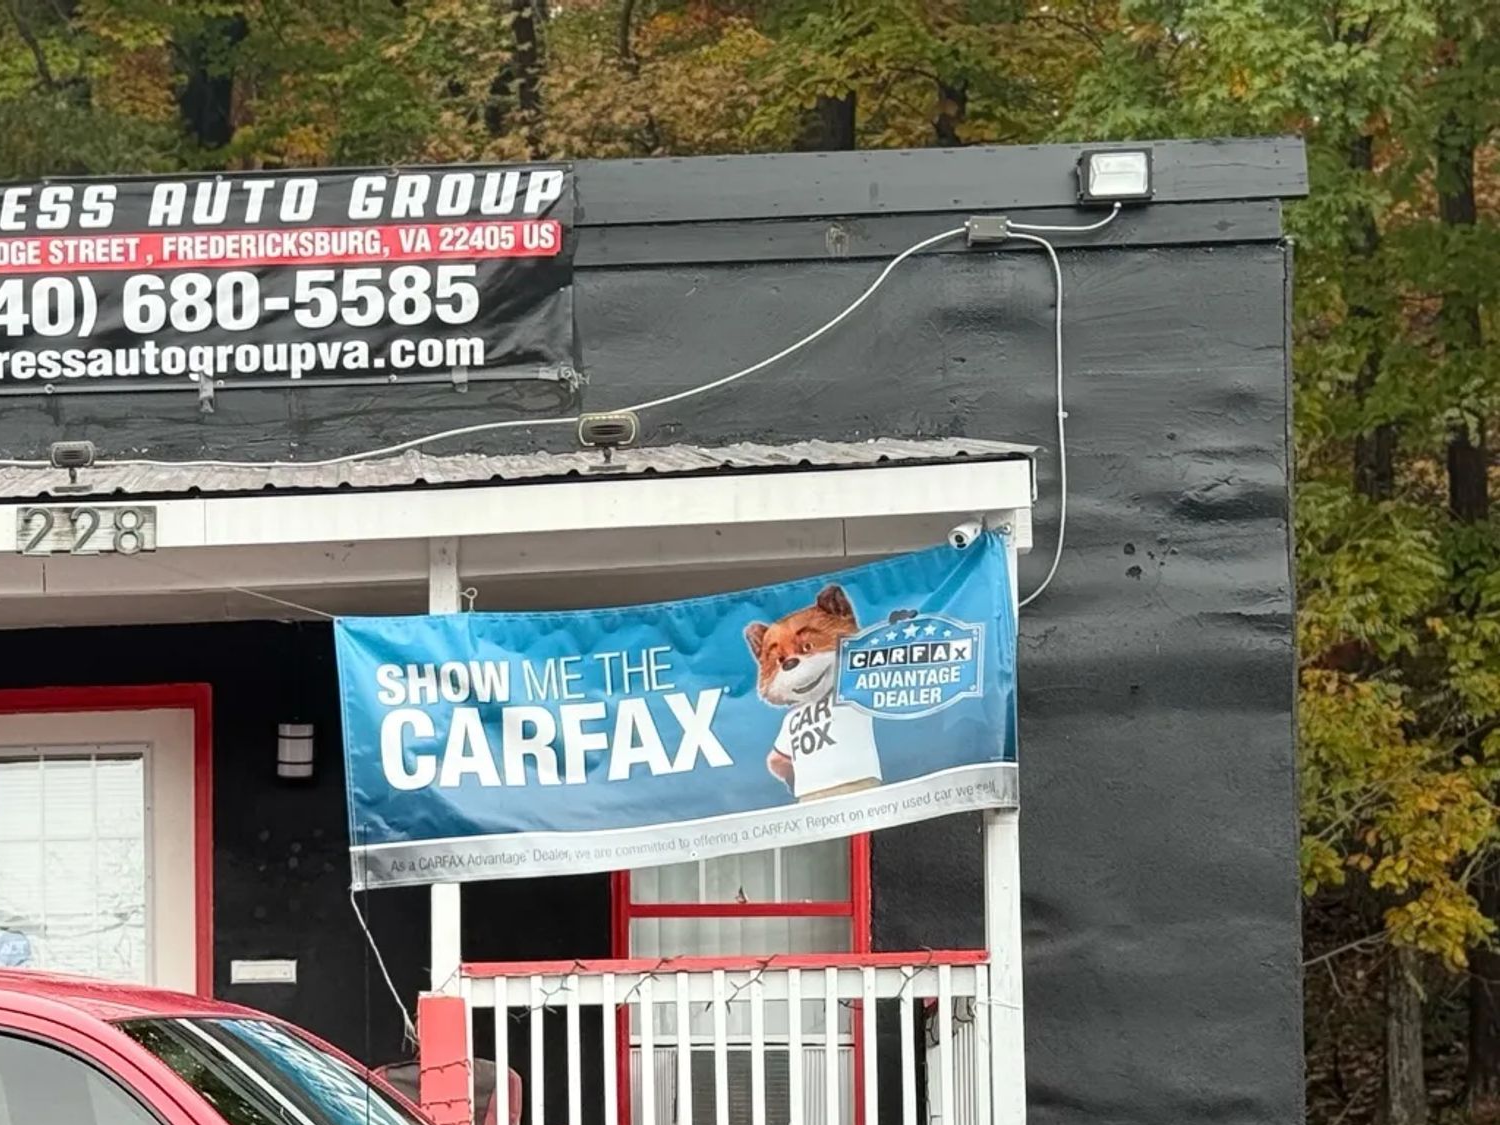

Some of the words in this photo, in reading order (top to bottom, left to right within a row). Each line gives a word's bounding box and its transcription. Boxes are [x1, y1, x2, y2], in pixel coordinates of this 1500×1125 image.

[148, 178, 319, 226] AUTO
[347, 170, 564, 220] GROUP
[162, 229, 390, 262] FREDERICKSBURG,
[399, 229, 431, 253] VA
[438, 226, 515, 251] 22405
[523, 224, 556, 249] US
[123, 265, 479, 334] 680-5585
[22, 506, 145, 556] 228
[376, 660, 510, 706] SHOW
[522, 655, 585, 701] ME
[594, 646, 676, 696] THE
[851, 641, 970, 669] CARFAX
[855, 666, 961, 690] ADVANTAGE
[873, 687, 942, 709] DEALER
[380, 688, 734, 791] CARFAX
[789, 698, 832, 736] CAR
[791, 721, 837, 762] FOX
[391, 860, 405, 872] As
[408, 863, 416, 872] a
[419, 855, 465, 871] CARFAX
[467, 850, 527, 870] Advantage
[533, 847, 572, 863] Dealer,
[575, 850, 591, 861] we
[594, 847, 612, 859] are
[615, 840, 676, 857] committed
[679, 838, 691, 850] to
[693, 828, 739, 848] offering
[753, 822, 800, 840] CARFAX
[805, 813, 846, 833] Report
[849, 808, 864, 822] on
[867, 802, 899, 820] every
[902, 792, 932, 810] used
[934, 788, 953, 803] car
[957, 784, 975, 798] we
